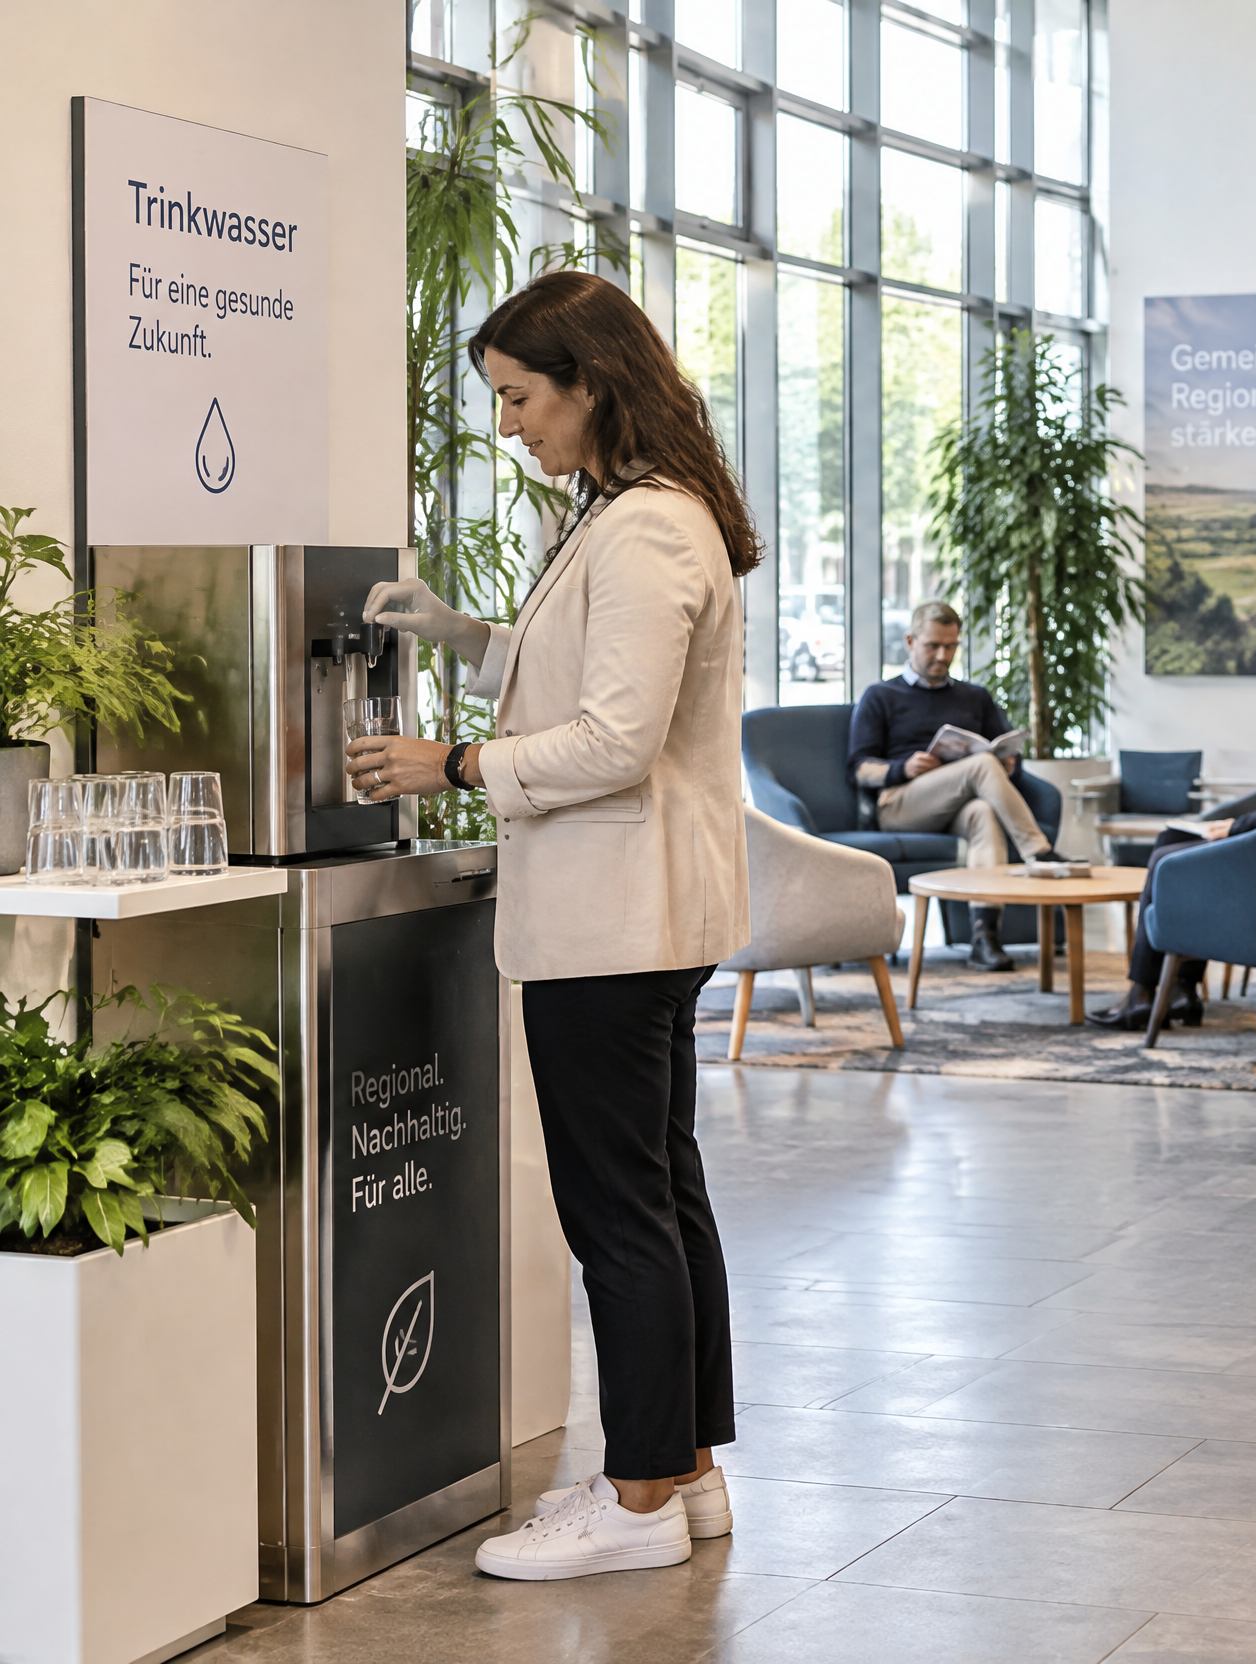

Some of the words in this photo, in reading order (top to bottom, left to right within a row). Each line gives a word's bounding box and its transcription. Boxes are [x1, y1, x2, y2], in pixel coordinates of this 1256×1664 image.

[127, 179, 298, 253] Trinkwasser
[128, 262, 163, 301] Für
[168, 272, 209, 308] eine
[214, 287, 294, 321] gesunde
[128, 315, 212, 359] Zukunft.
[352, 1053, 444, 1109] Regional.
[352, 1102, 467, 1160] Nachhaltig.
[352, 1174, 386, 1213] Für
[392, 1160, 433, 1201] alle.
